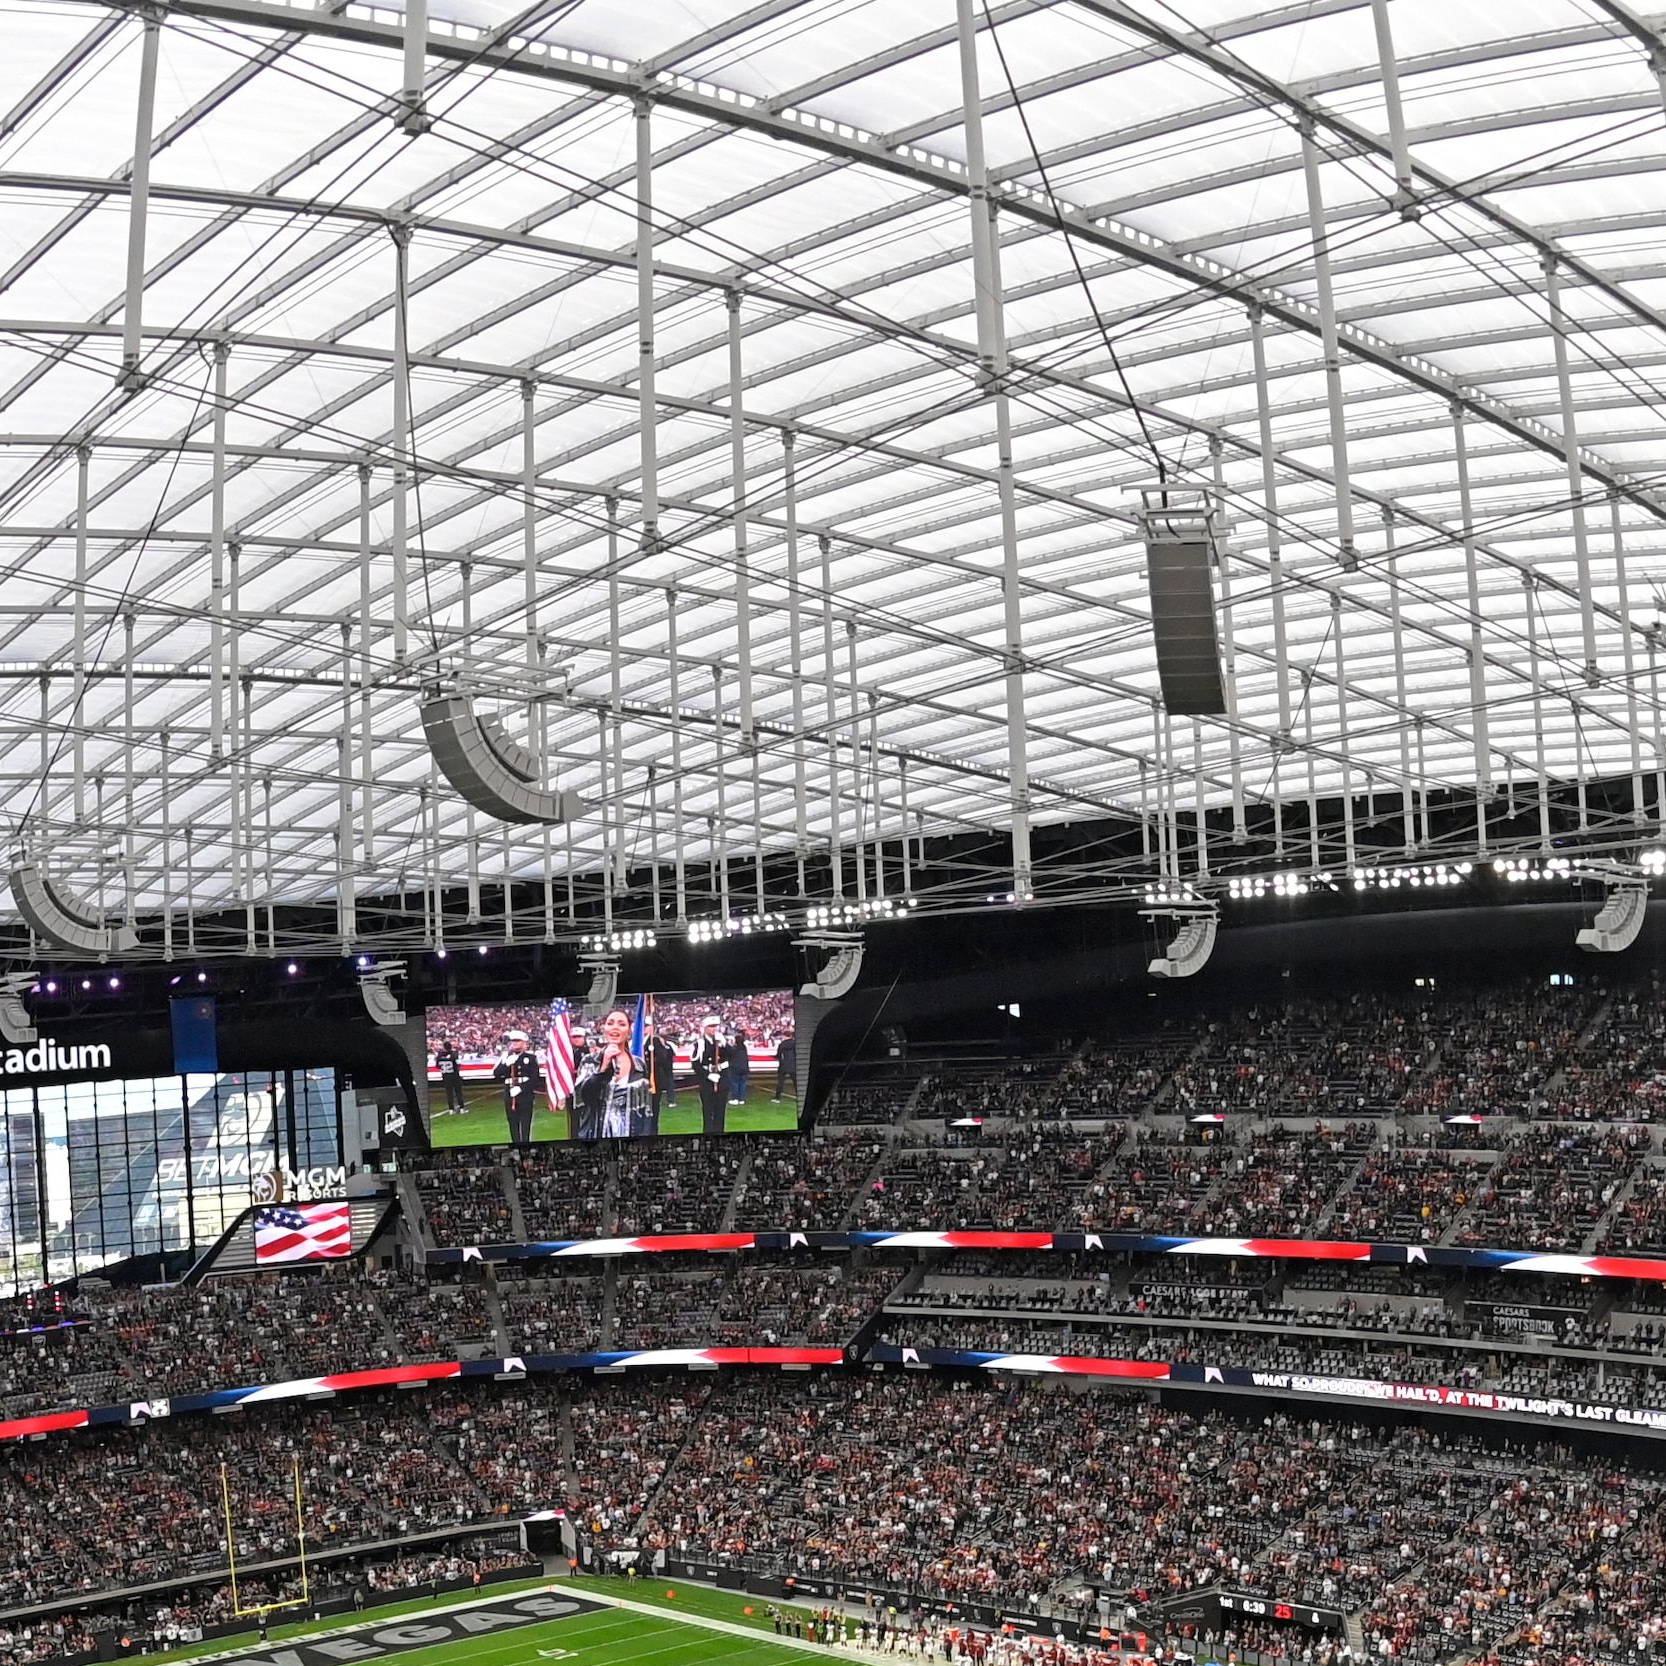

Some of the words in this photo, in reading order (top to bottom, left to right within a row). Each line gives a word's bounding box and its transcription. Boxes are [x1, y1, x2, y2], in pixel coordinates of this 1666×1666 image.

[286, 1166, 346, 1186] MGM
[1493, 1307, 1530, 1317] CAESARS
[1252, 1373, 1289, 1387] WHAT
[1446, 1392, 1463, 1404] AT
[1466, 1393, 1493, 1408] THE
[1576, 1405, 1613, 1420] LAST
[1275, 1604, 1292, 1619] 25
